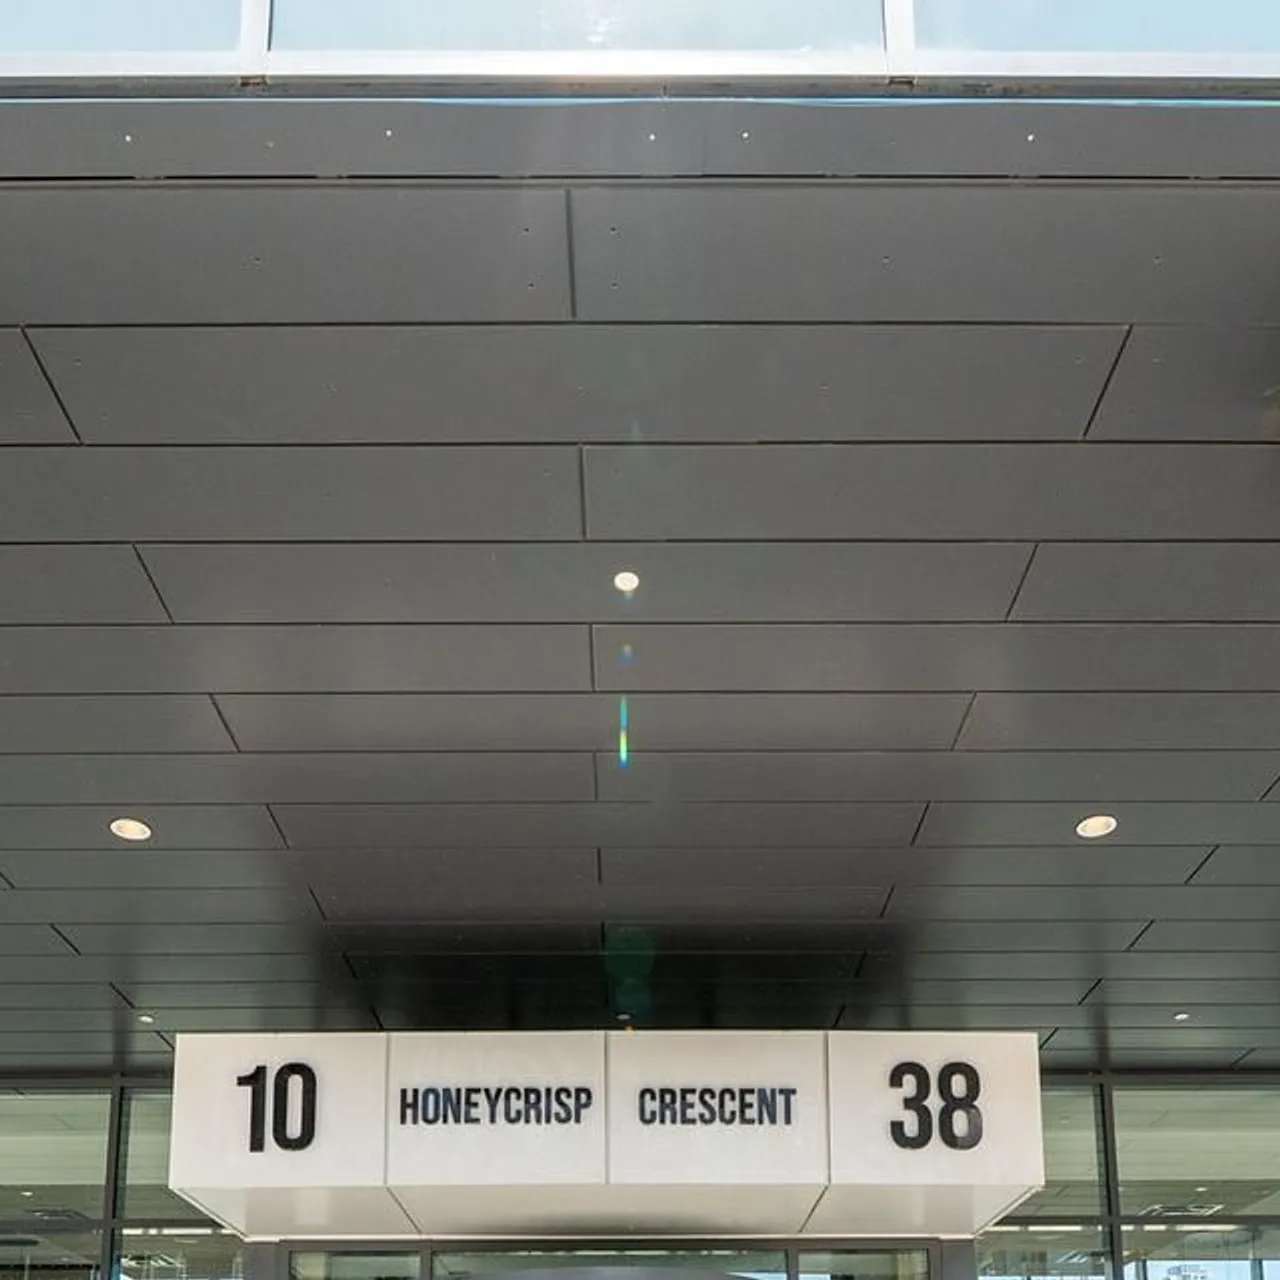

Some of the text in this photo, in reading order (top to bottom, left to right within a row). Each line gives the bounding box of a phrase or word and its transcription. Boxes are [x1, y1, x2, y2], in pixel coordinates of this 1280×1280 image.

[236, 1061, 982, 1153] 10 HONEYCRISP CRESCENT 38
